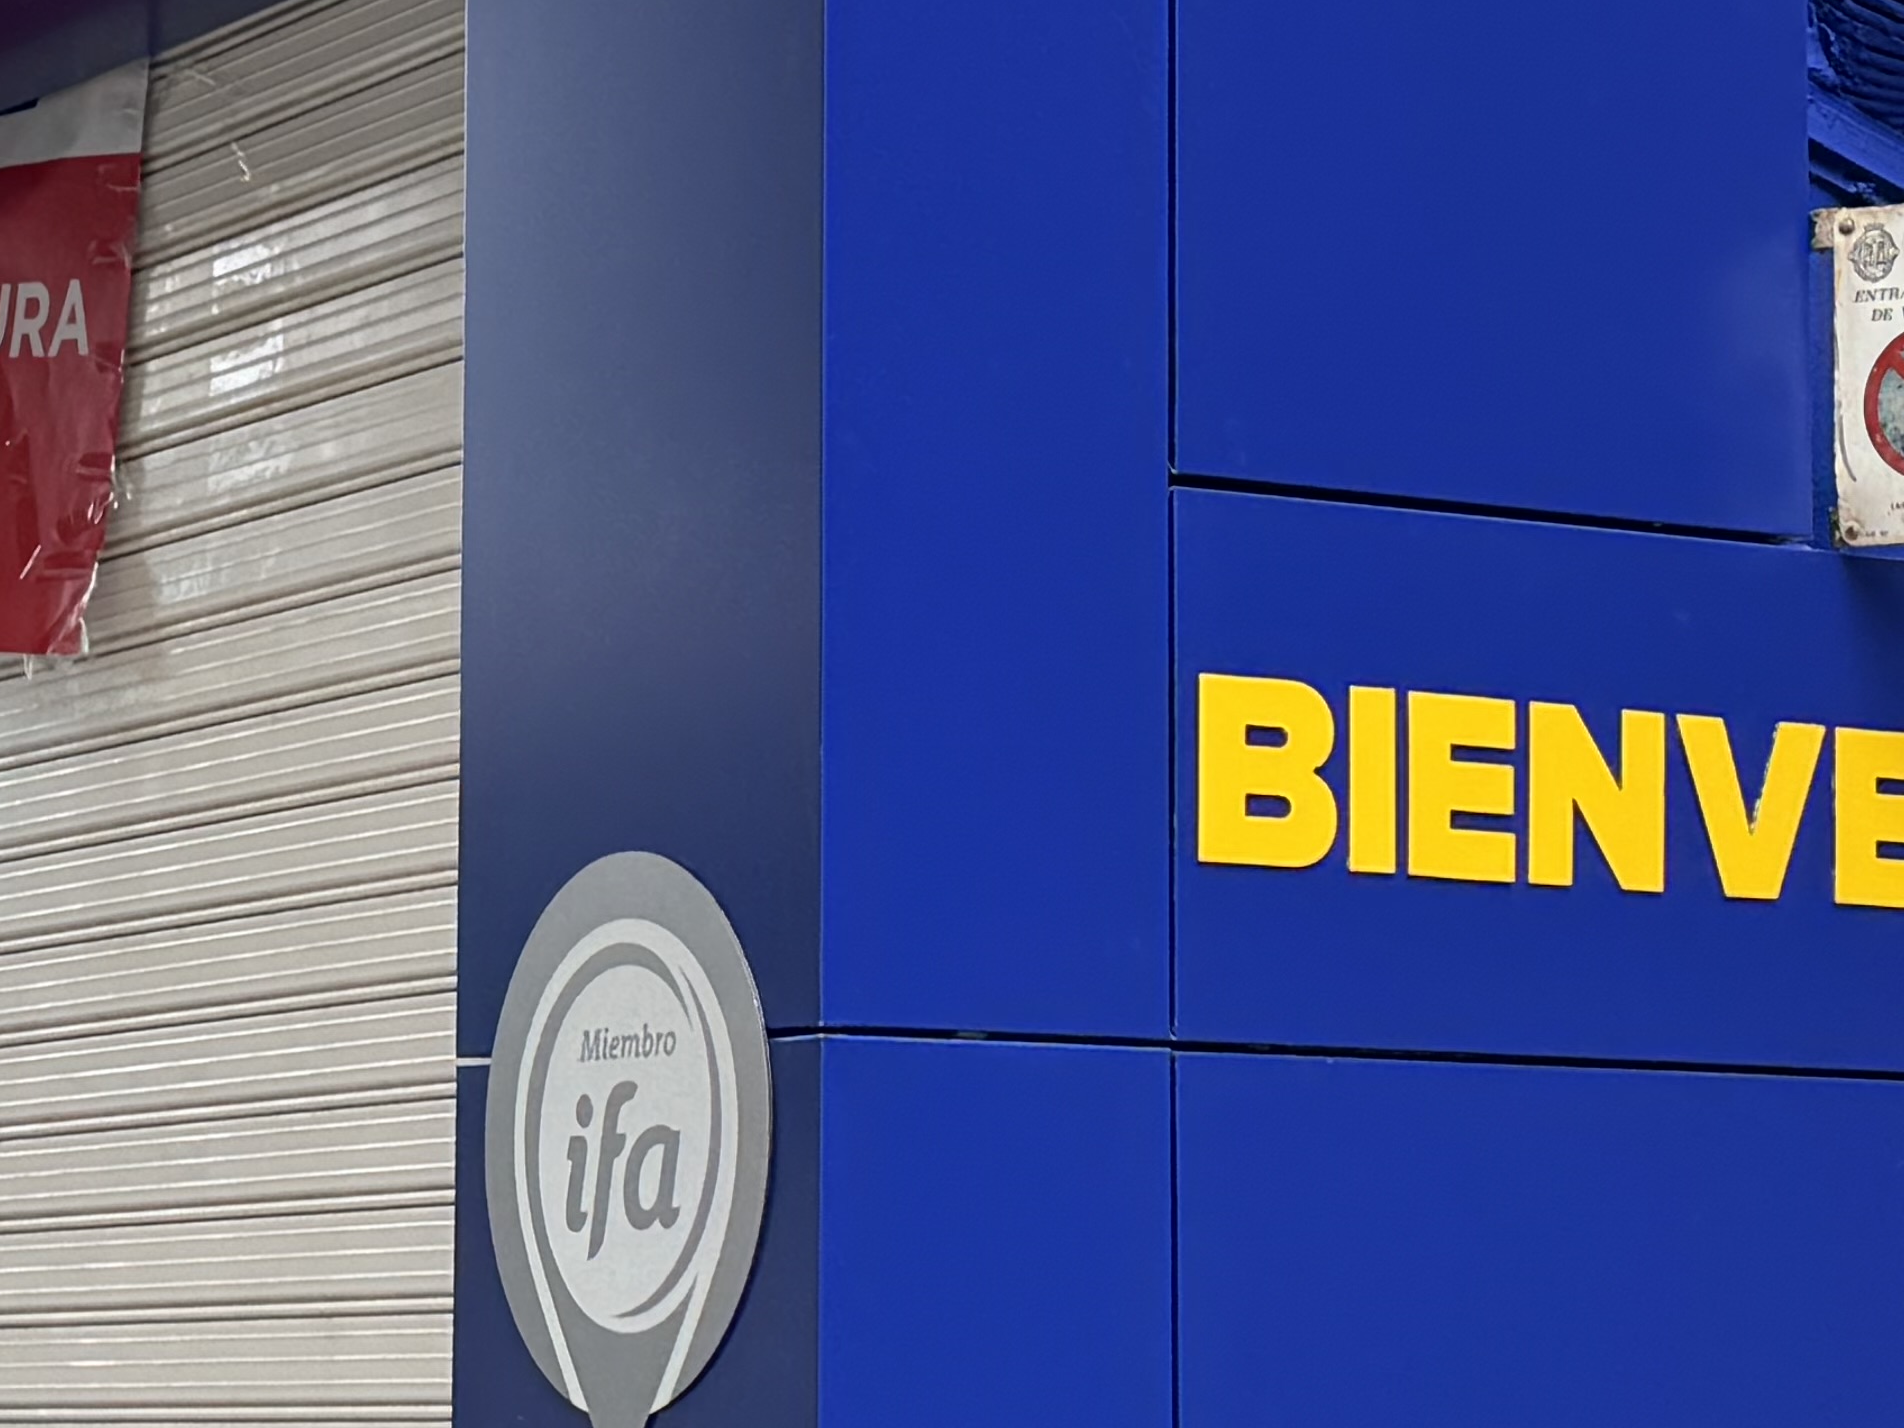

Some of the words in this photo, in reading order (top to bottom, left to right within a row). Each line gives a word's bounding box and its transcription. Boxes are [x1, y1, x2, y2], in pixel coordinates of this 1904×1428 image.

[1871, 307, 1894, 323] DE
[579, 1023, 677, 1063] Miembro
[565, 1080, 682, 1262] ifa
